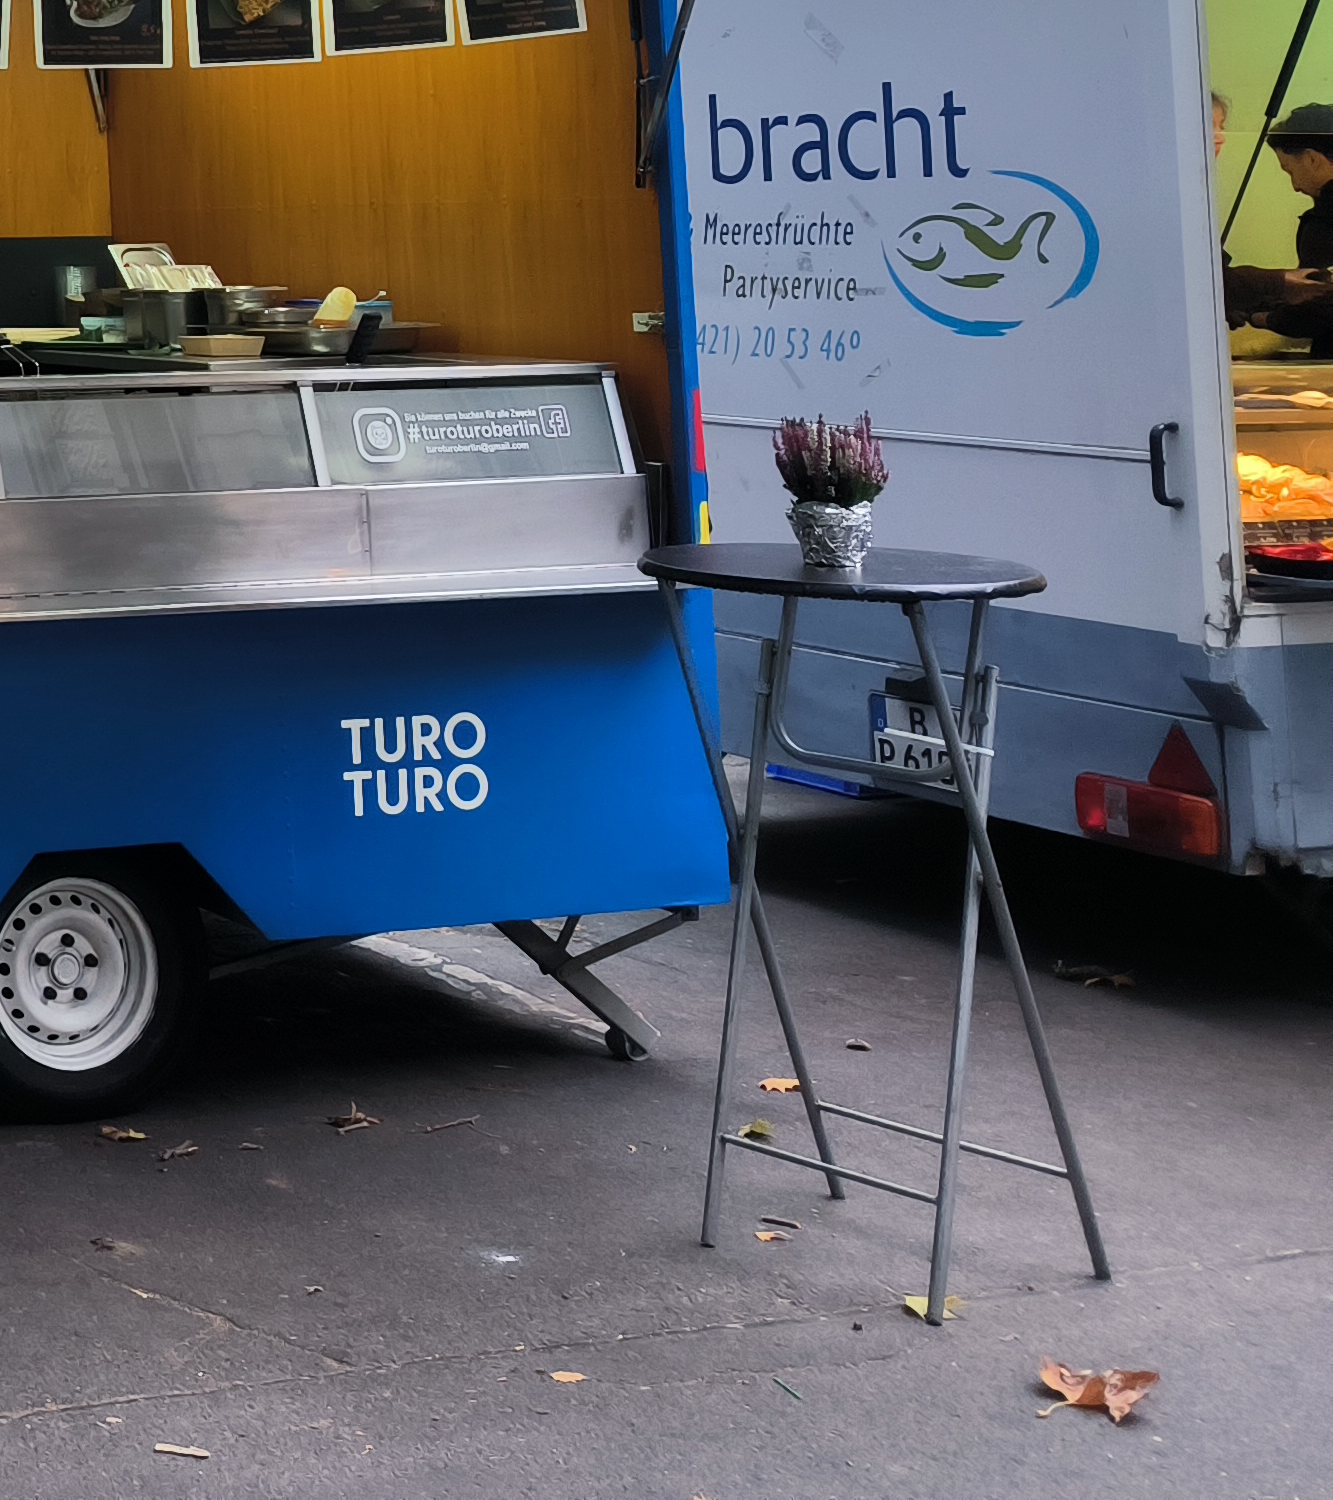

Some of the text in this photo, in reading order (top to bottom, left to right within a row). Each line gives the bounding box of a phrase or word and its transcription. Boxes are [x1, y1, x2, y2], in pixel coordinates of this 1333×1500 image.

[708, 81, 971, 185] bracht
[702, 210, 855, 246] Meeresfrüchte
[722, 264, 858, 311] Partyservice
[749, 325, 776, 358] 20
[783, 327, 810, 360] 53
[406, 420, 541, 444] #turoturoberlin
[425, 441, 530, 454] turoturoberlin@gmail.com
[340, 711, 487, 765] TURO
[908, 706, 929, 737] B
[342, 763, 489, 817] TURO
